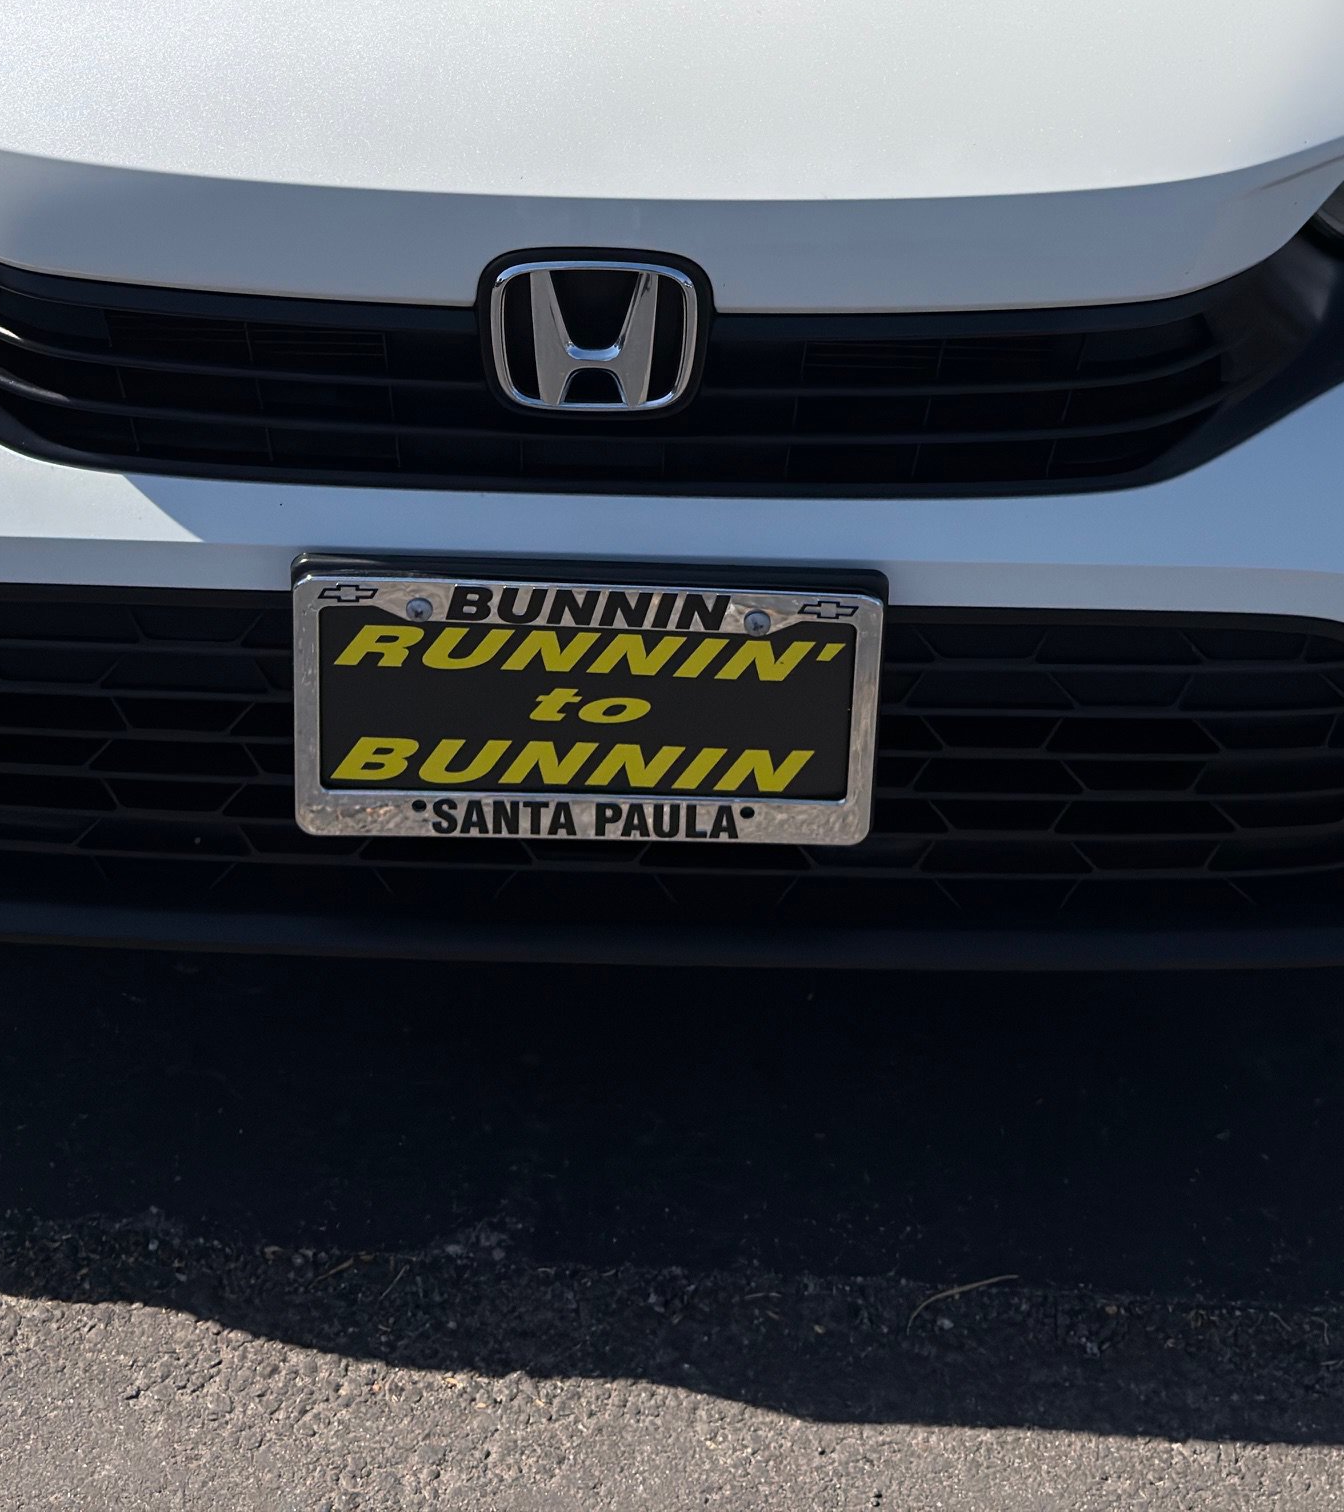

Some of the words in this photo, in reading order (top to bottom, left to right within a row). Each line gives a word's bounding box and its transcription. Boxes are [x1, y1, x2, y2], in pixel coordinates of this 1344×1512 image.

[446, 586, 731, 632] BUNNIN
[334, 624, 846, 682] RUNNIN'
[529, 687, 651, 724] to
[331, 736, 815, 793] BUNNIN
[432, 799, 577, 837] SANTA
[593, 801, 739, 840] PAULA
